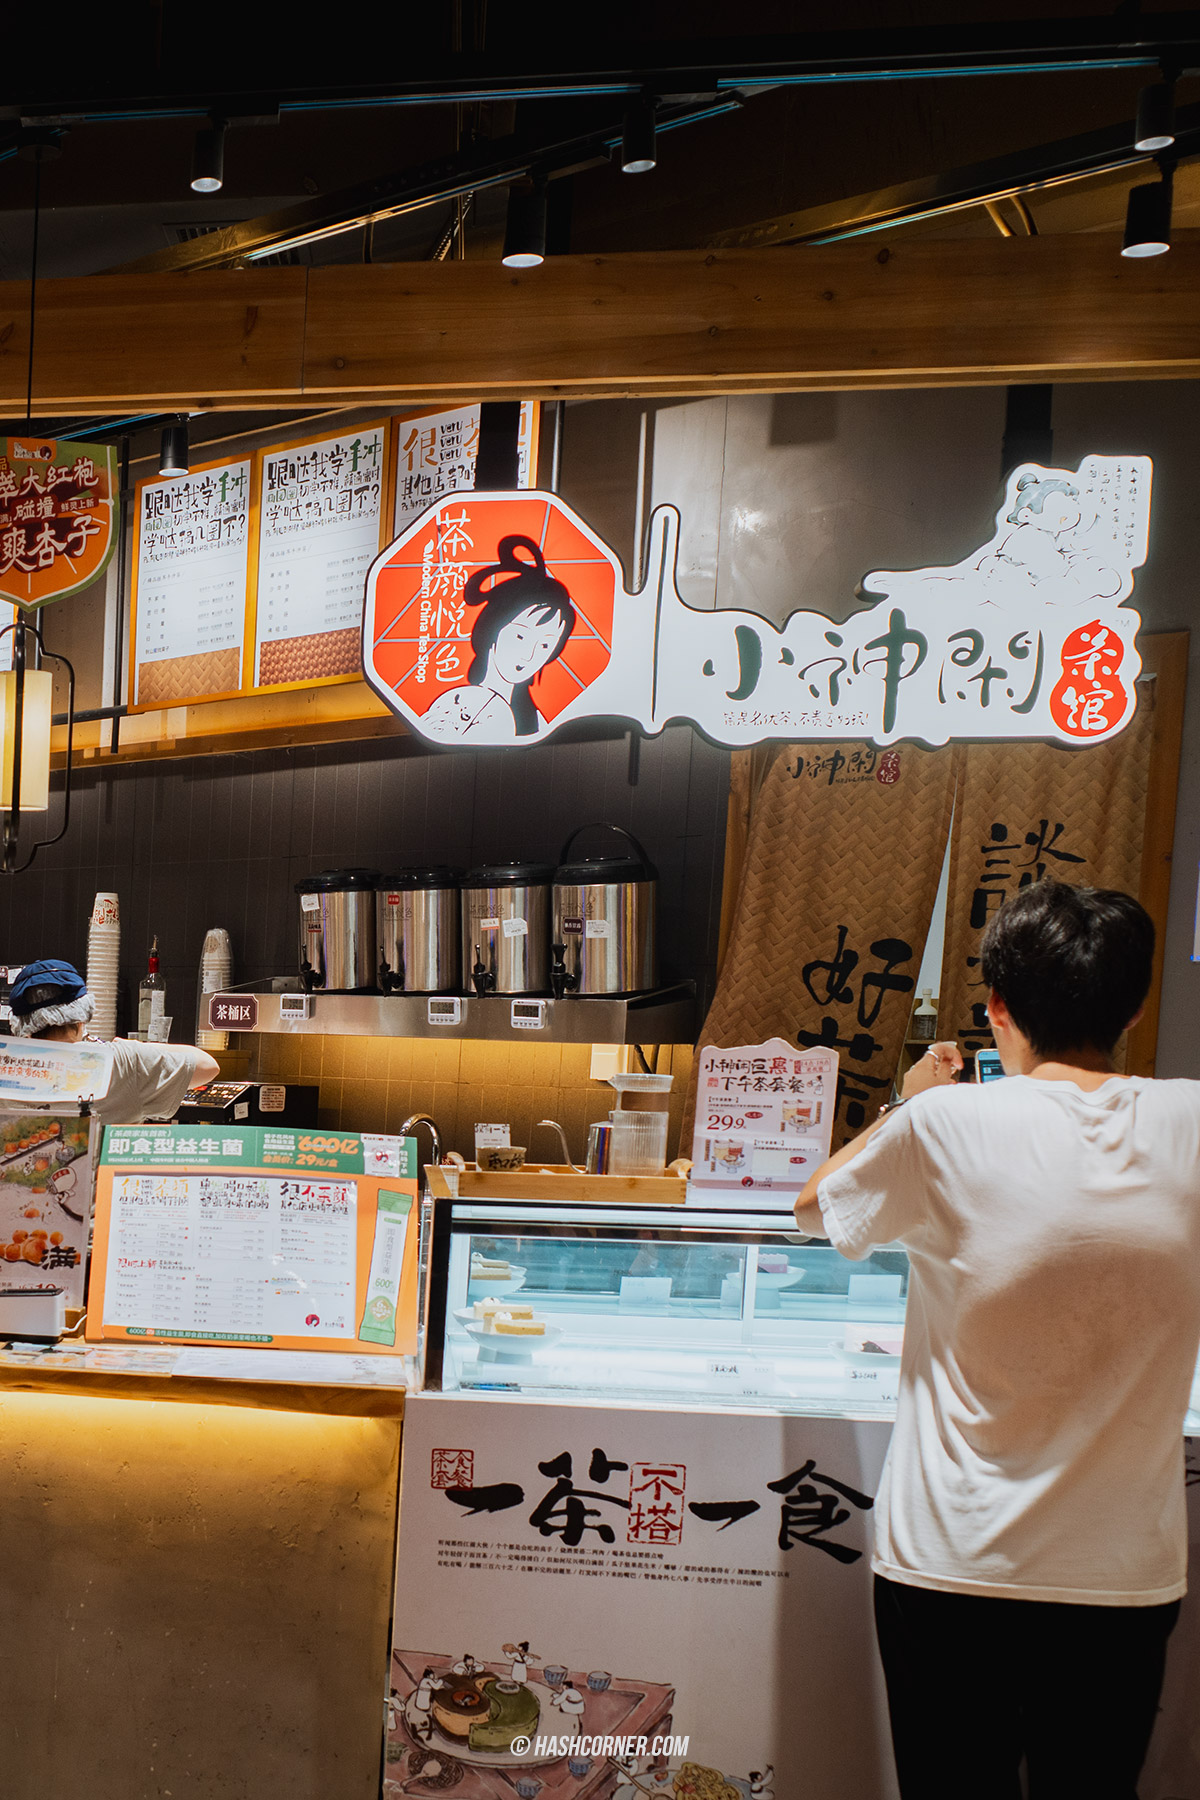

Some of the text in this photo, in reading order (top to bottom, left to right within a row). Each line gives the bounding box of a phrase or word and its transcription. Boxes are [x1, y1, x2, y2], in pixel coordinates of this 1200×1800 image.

[402, 428, 439, 472] 很
[14, 497, 56, 522] 碰撞
[415, 554, 431, 683] Modern China Tea Shop
[216, 1004, 251, 1020] 茶桶区
[721, 1075, 804, 1094] 下午茶套餐
[707, 1114, 745, 1131] 29.9
[108, 1137, 244, 1156] 即食型益生菌
[41, 1246, 77, 1270] 满
